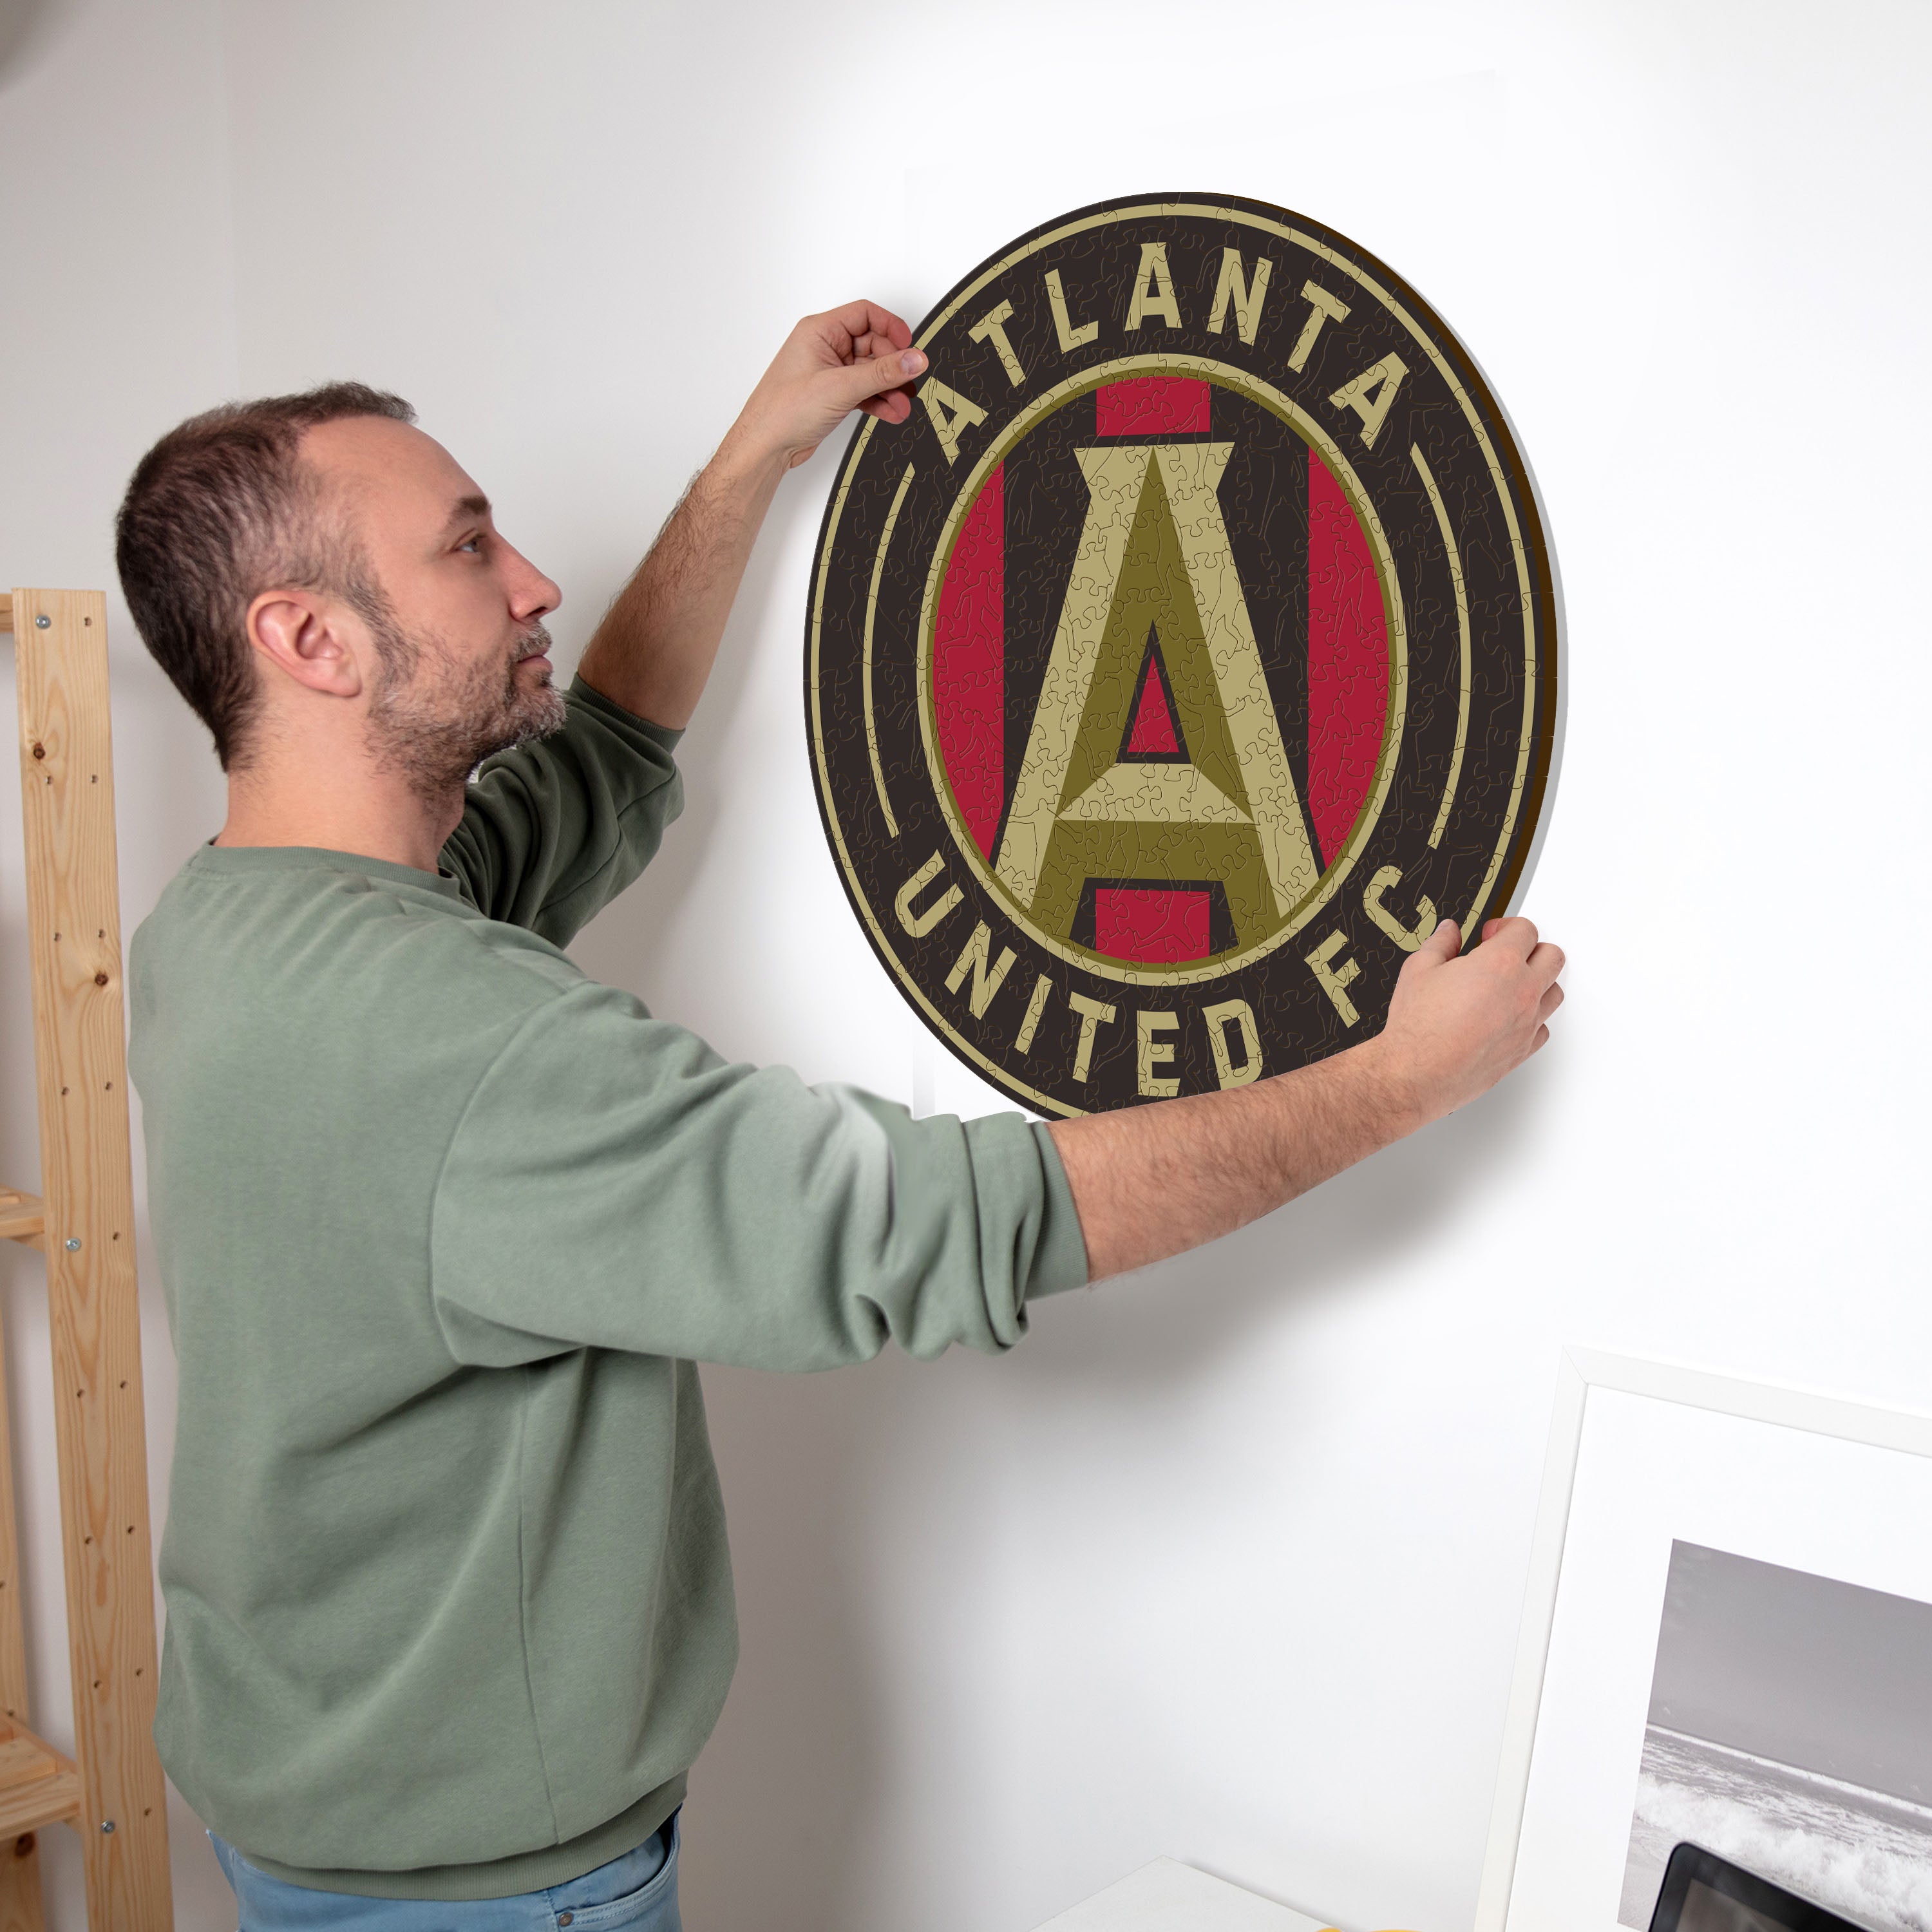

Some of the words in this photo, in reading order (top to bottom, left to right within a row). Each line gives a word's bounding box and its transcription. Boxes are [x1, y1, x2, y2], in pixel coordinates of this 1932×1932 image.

[917, 242, 1410, 467] ATLANTA
[896, 849, 1264, 1097] UNITED
[1304, 865, 1437, 1028] FC
